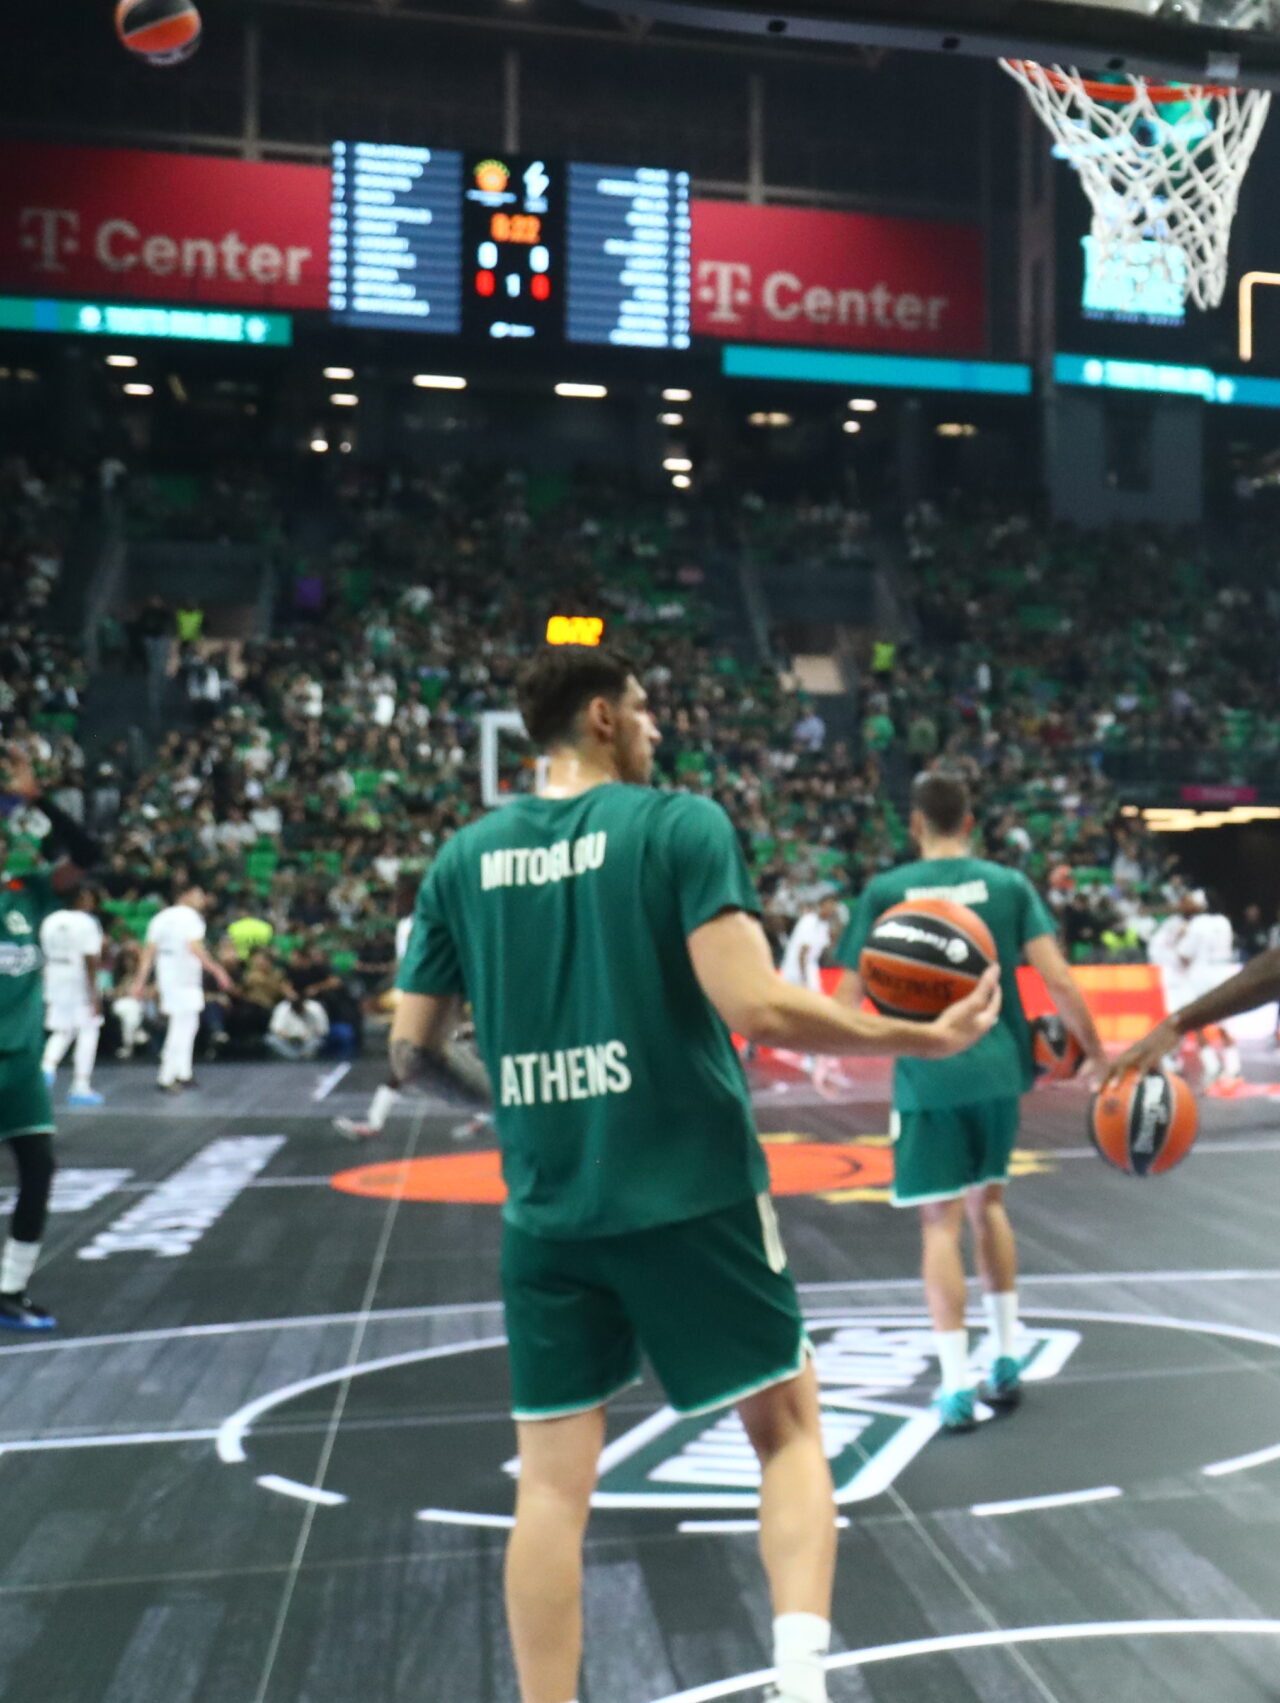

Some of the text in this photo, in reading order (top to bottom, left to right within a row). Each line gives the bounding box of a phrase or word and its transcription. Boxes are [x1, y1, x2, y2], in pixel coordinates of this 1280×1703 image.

[96, 218, 312, 284] Center
[762, 270, 947, 330] Center
[501, 1040, 632, 1106] ATHENS
